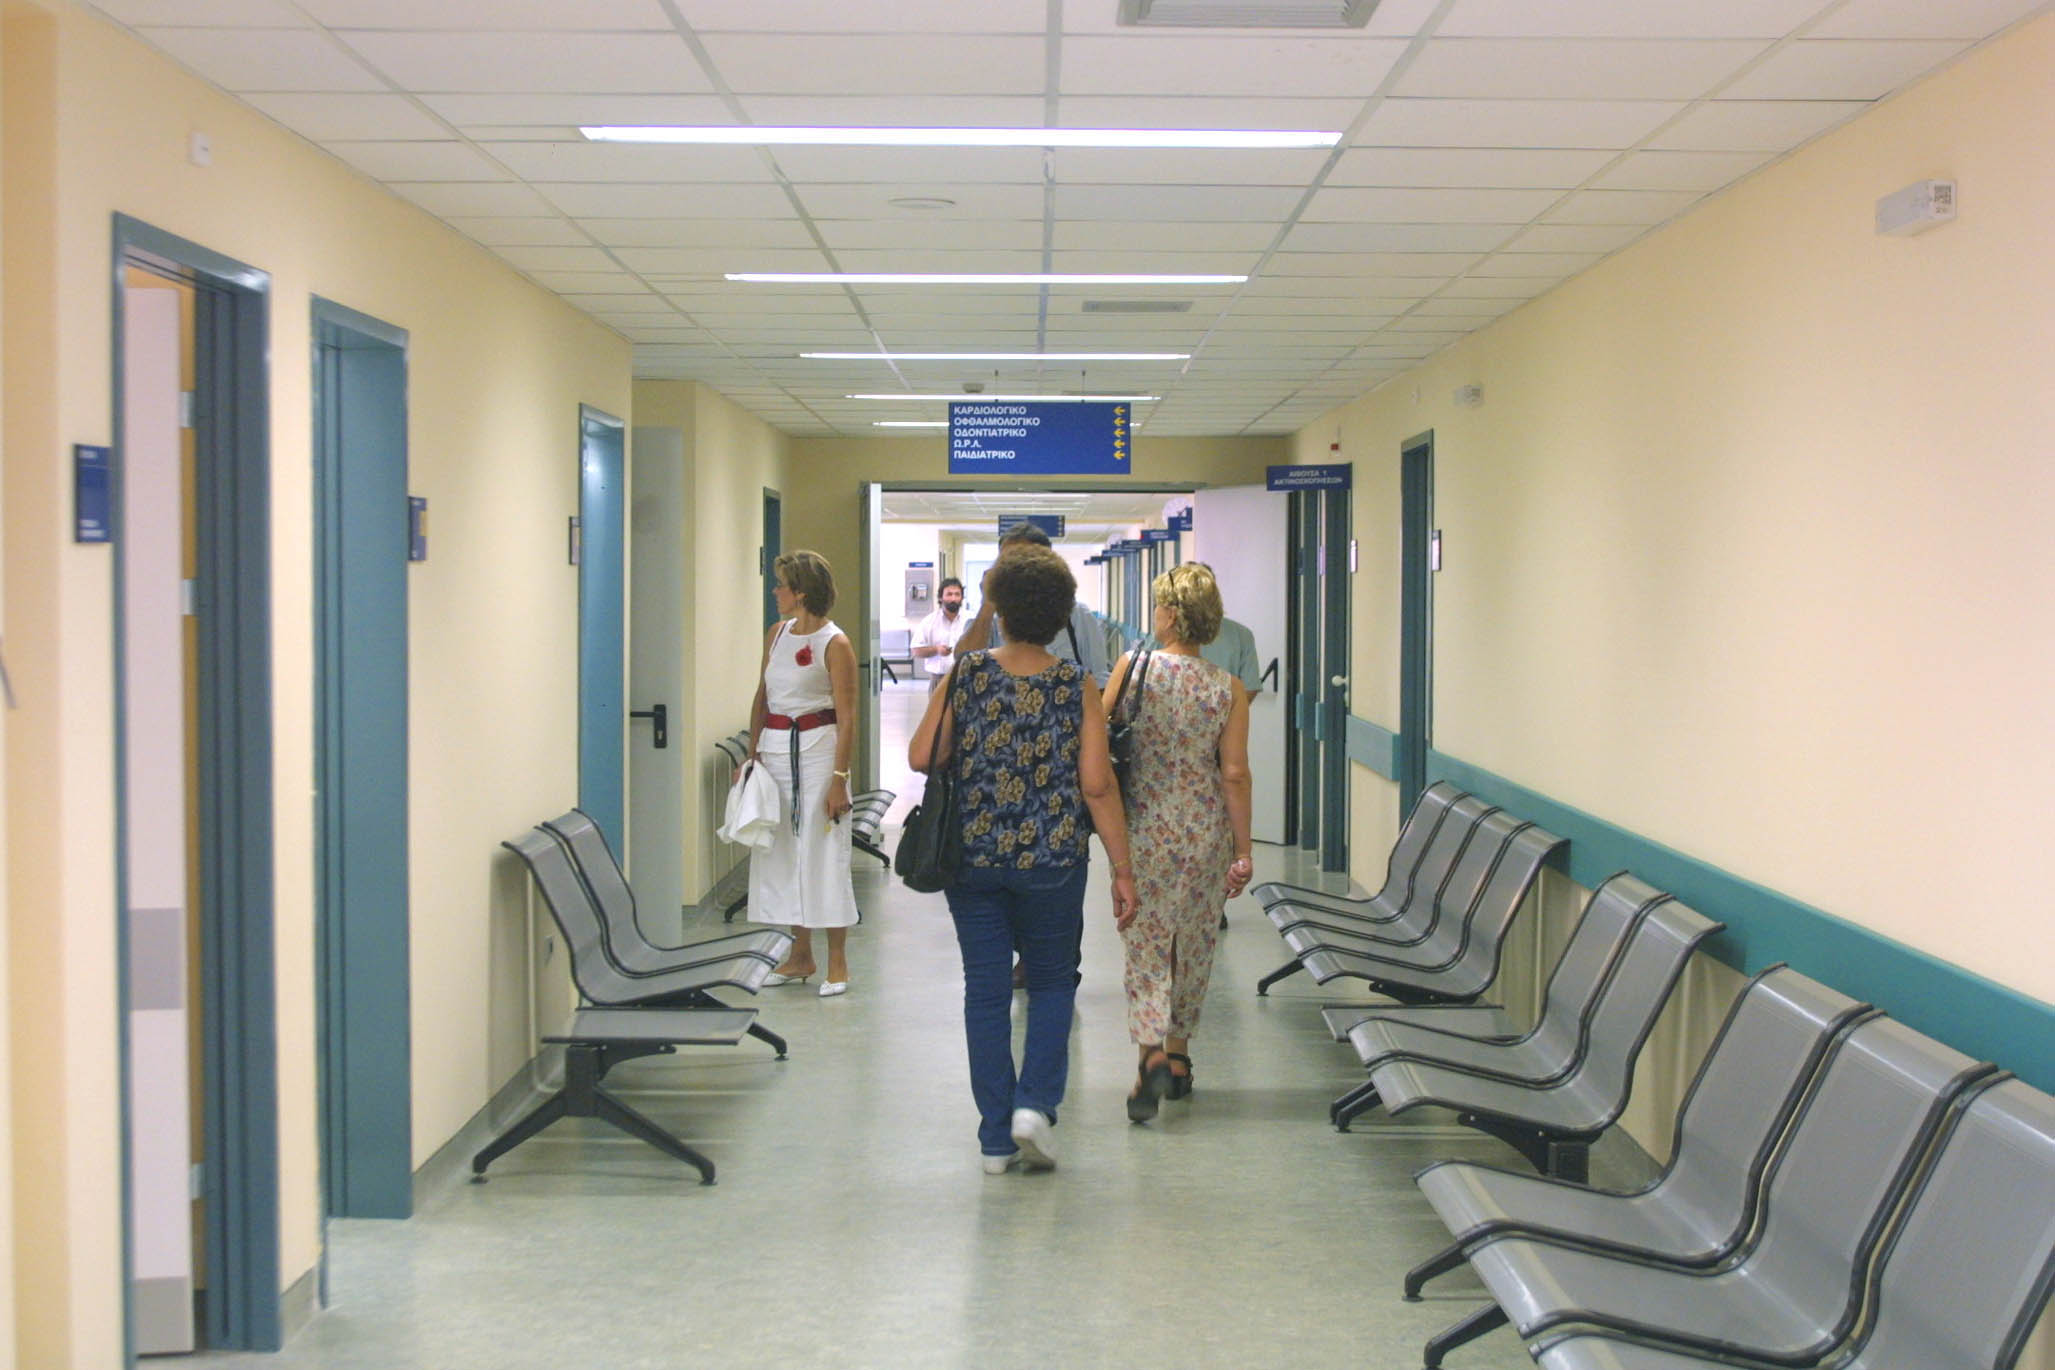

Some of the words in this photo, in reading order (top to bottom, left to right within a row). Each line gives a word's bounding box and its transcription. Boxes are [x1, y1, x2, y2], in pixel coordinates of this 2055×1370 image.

[953, 406, 1027, 415] ΚΑΡΔΙΟΛΟΓΙΚΟ
[953, 417, 1041, 426] ΟΦΘΑΛΜΟΛΟΓΙΚΟ
[953, 428, 1027, 437] ΟΔΟΝΤΙΑΤΡΙΚΟ
[953, 450, 1016, 459] ΠΑΙΔΙΑΤΡΙΚΟ
